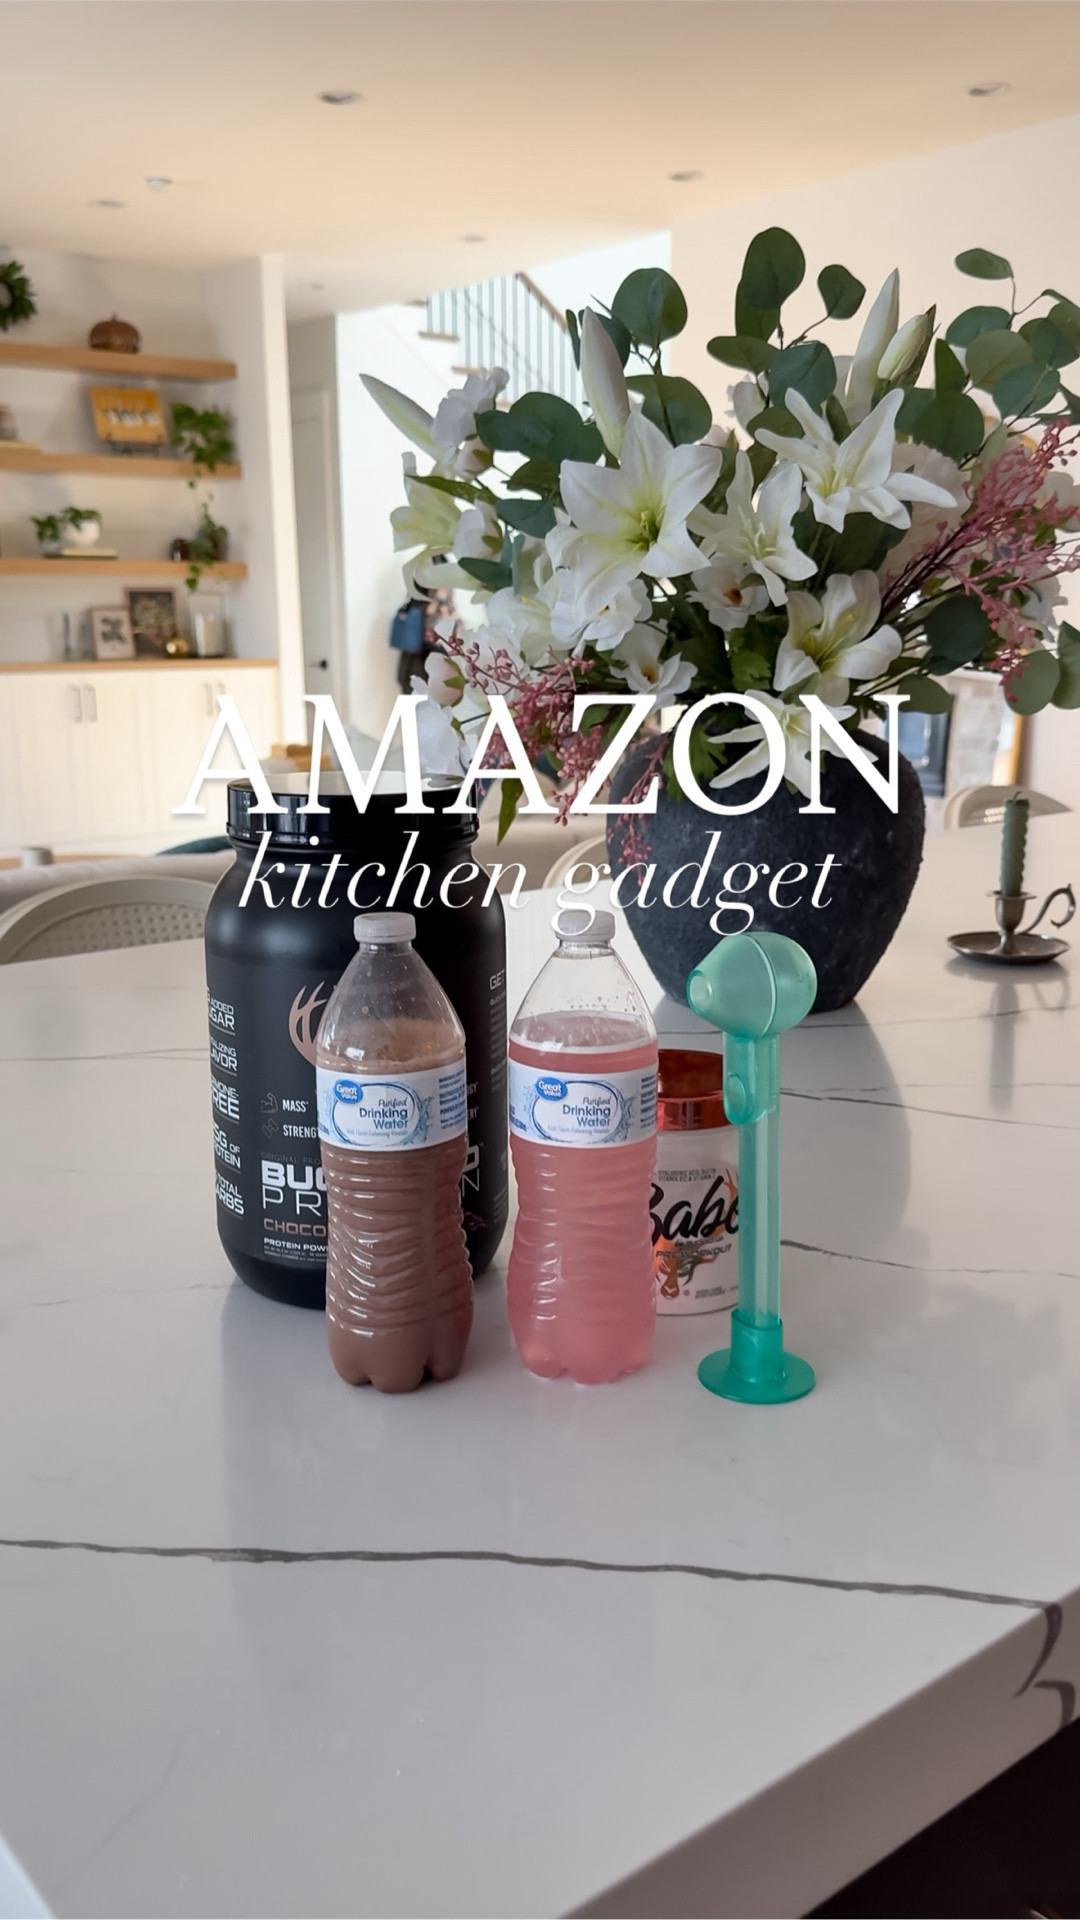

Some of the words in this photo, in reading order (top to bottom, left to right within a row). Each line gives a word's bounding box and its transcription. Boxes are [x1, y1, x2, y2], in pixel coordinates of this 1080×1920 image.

[538, 1080, 562, 1092] Great
[212, 1086, 240, 1120] REE
[359, 1107, 408, 1120] Drinking
[562, 1104, 611, 1118] Drinking
[373, 1119, 408, 1130] Water
[576, 1117, 611, 1127] Water
[283, 1124, 319, 1139] STRENG
[263, 1218, 327, 1238] CHOCO
[263, 1237, 301, 1250] PROTEIN
[303, 1243, 328, 1252] POW
